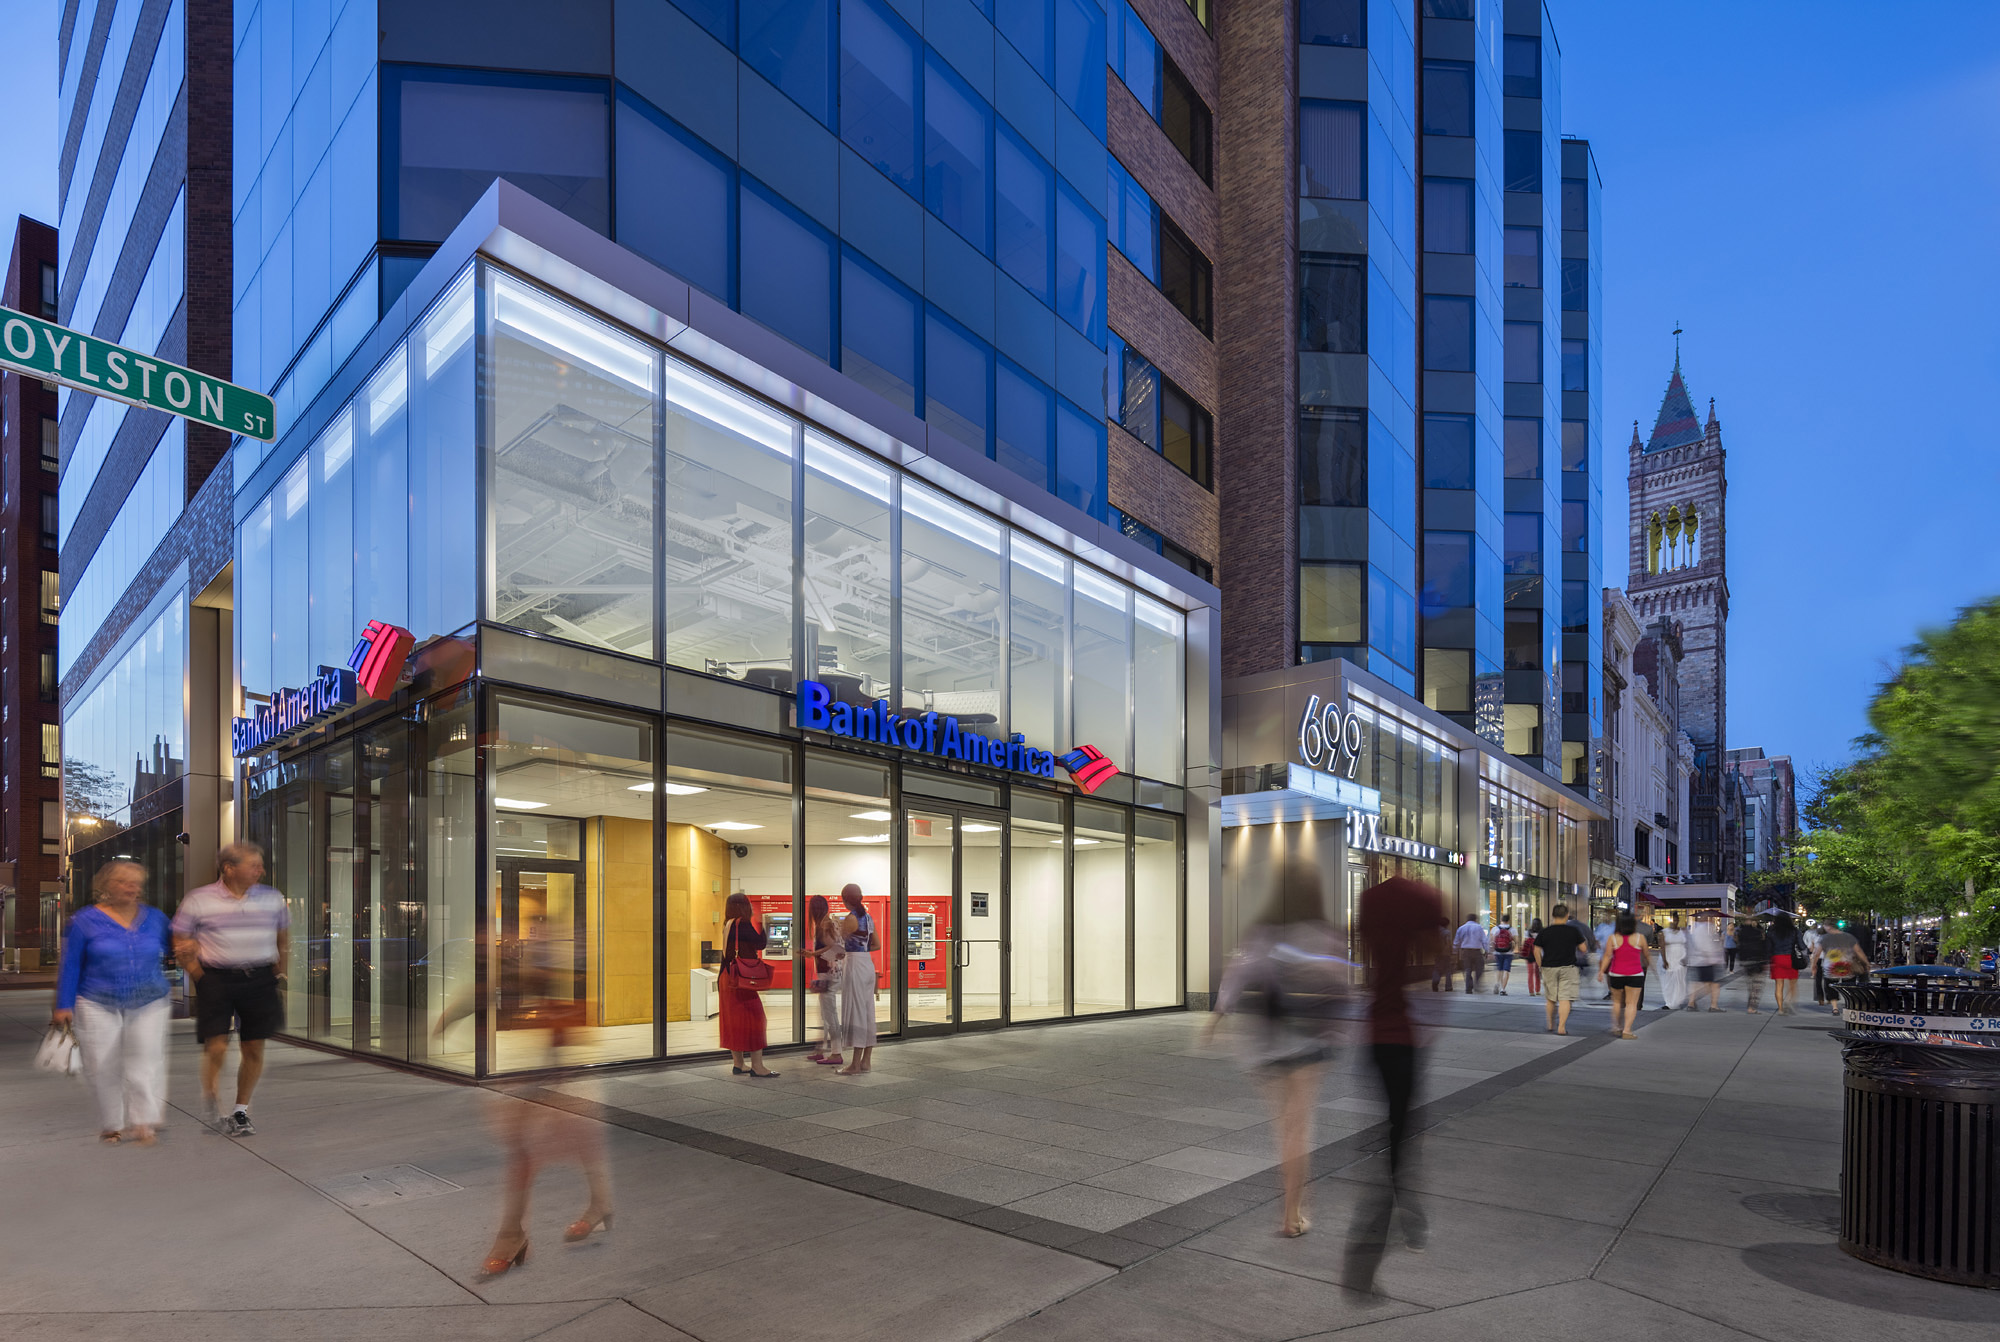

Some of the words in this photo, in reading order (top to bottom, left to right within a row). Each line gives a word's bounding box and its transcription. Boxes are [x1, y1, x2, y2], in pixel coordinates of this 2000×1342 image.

[244, 412, 266, 434] ST
[232, 704, 262, 757] Bank
[277, 666, 342, 736] America
[798, 680, 900, 746] Bank
[904, 712, 938, 753] of
[942, 716, 1054, 778] America
[1301, 695, 1363, 779] 699
[1384, 838, 1435, 859] STUDIO
[1859, 1012, 1905, 1025] Recycle
